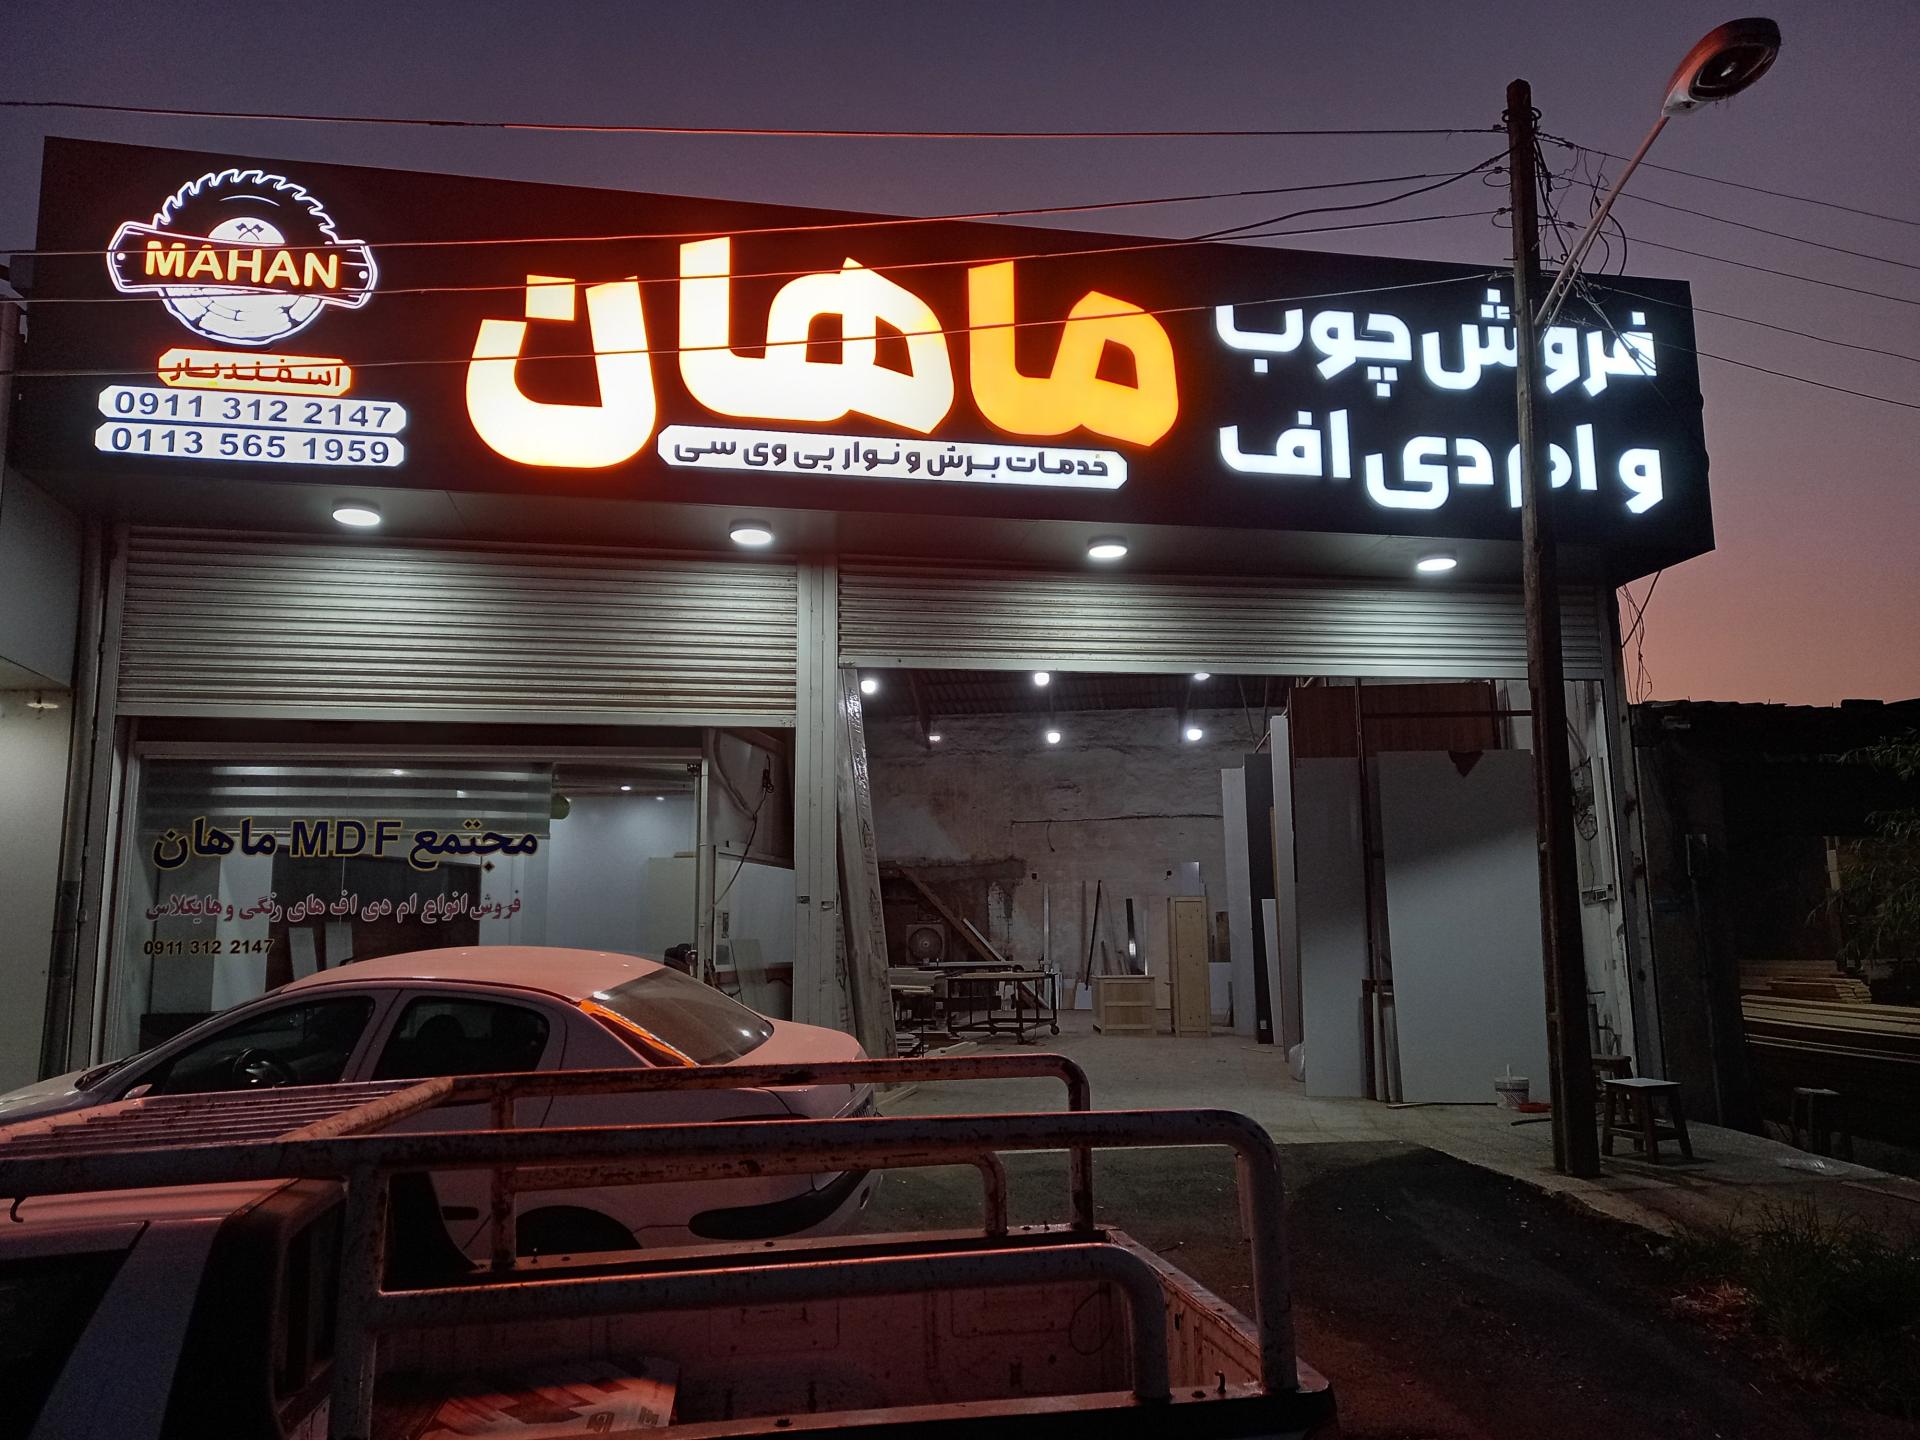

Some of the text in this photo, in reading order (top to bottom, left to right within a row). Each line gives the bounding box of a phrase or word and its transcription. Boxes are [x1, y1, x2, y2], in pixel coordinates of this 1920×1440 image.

[145, 240, 338, 289] MAHAN
[466, 236, 1179, 470] ماهان
[1215, 288, 1658, 398] فروش چوب
[114, 391, 391, 428] 0911 312 2147
[111, 427, 390, 464] 0113 565 1959
[674, 440, 737, 463] سی
[793, 447, 835, 472] پی
[842, 440, 900, 472] نوار
[1218, 409, 1351, 479] اف
[905, 451, 921, 474] و
[927, 445, 1000, 479] برش
[1006, 451, 1109, 477] خدمات
[1364, 436, 1495, 510] دی
[1618, 447, 1664, 515] و
[153, 816, 538, 871] مجتمع MDF ماهان
[239, 892, 283, 922] رنگی
[286, 893, 326, 922] های
[329, 889, 358, 916] اف
[361, 899, 392, 922] دی
[396, 892, 418, 924] ام
[421, 891, 468, 924] انواع
[469, 889, 521, 921] فروش
[143, 939, 275, 955] 0911 312 2147
